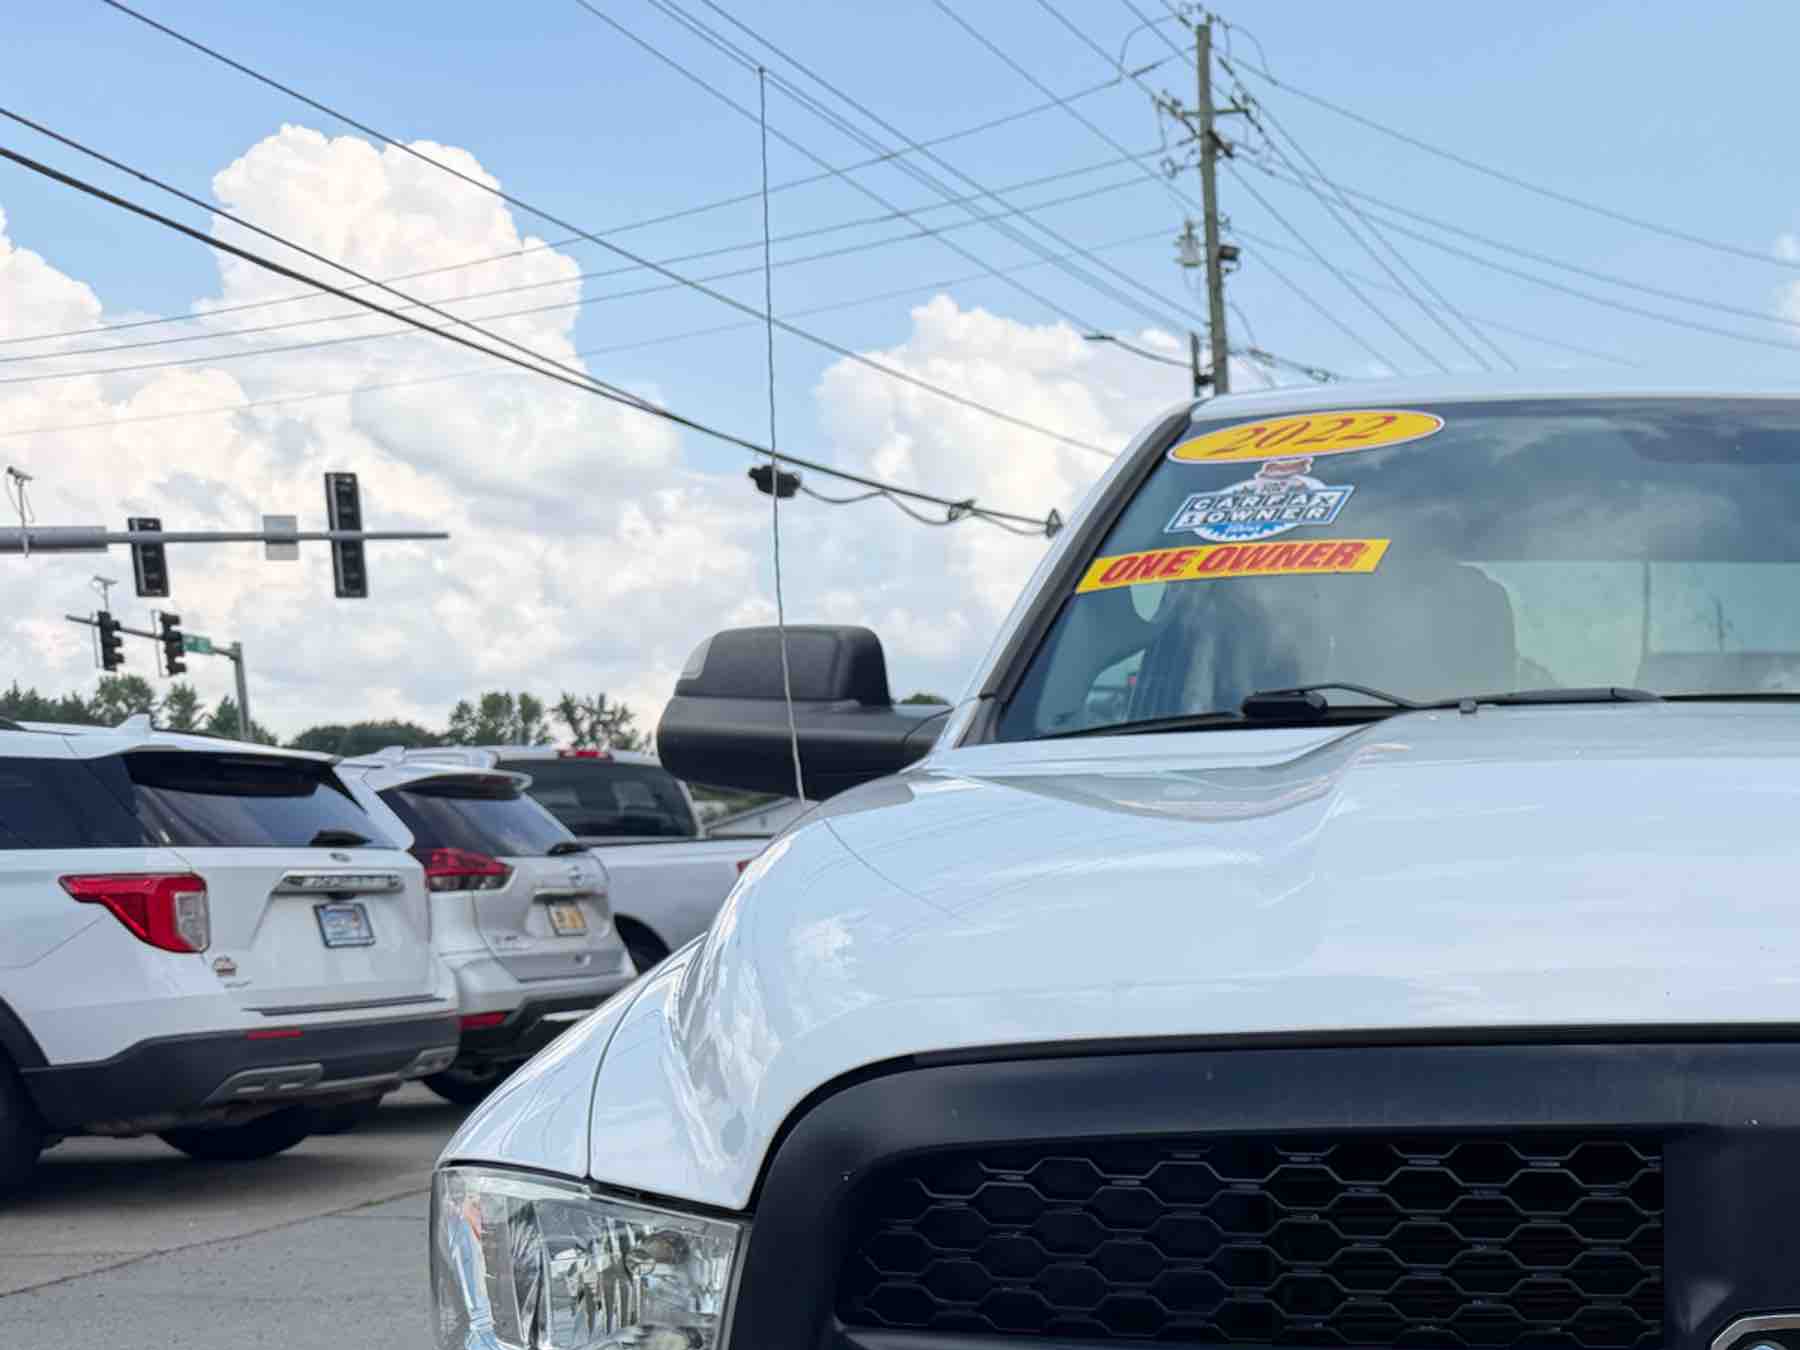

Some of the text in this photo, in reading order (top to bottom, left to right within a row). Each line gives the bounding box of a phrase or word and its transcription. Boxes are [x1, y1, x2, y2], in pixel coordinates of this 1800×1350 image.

[1204, 414, 1399, 457] 2022
[1192, 489, 1334, 511] CARFAX
[1099, 542, 1370, 585] ONE OWNER
